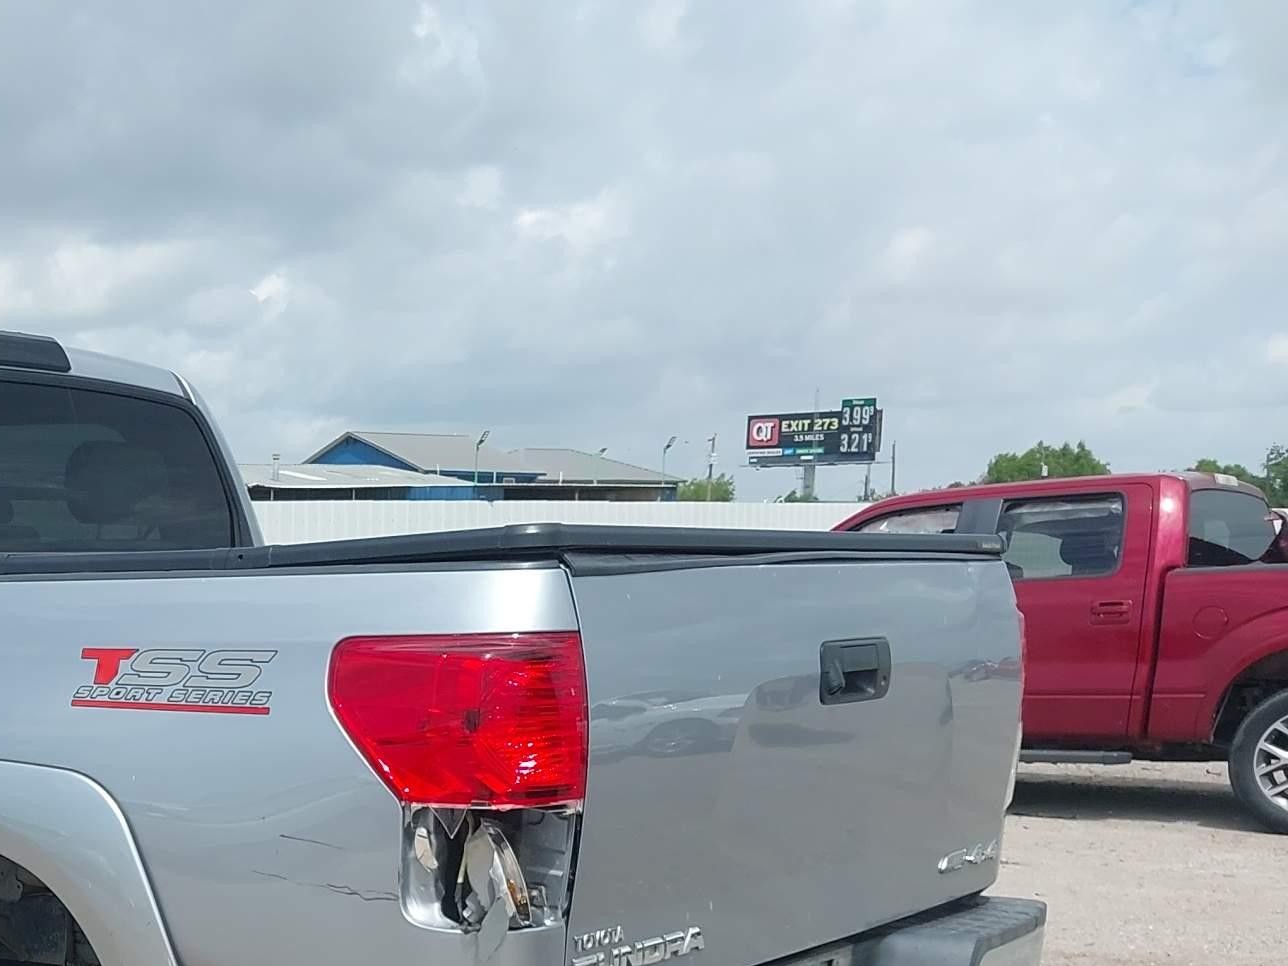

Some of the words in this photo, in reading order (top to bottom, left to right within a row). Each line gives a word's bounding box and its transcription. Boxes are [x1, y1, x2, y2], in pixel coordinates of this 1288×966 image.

[752, 422, 774, 441] QT
[781, 420, 810, 433] EXIT
[813, 418, 839, 431] 273
[81, 648, 278, 689] TSS
[73, 686, 162, 701] SPORT
[167, 689, 272, 705] SERIES
[573, 925, 624, 952] TOYOTA
